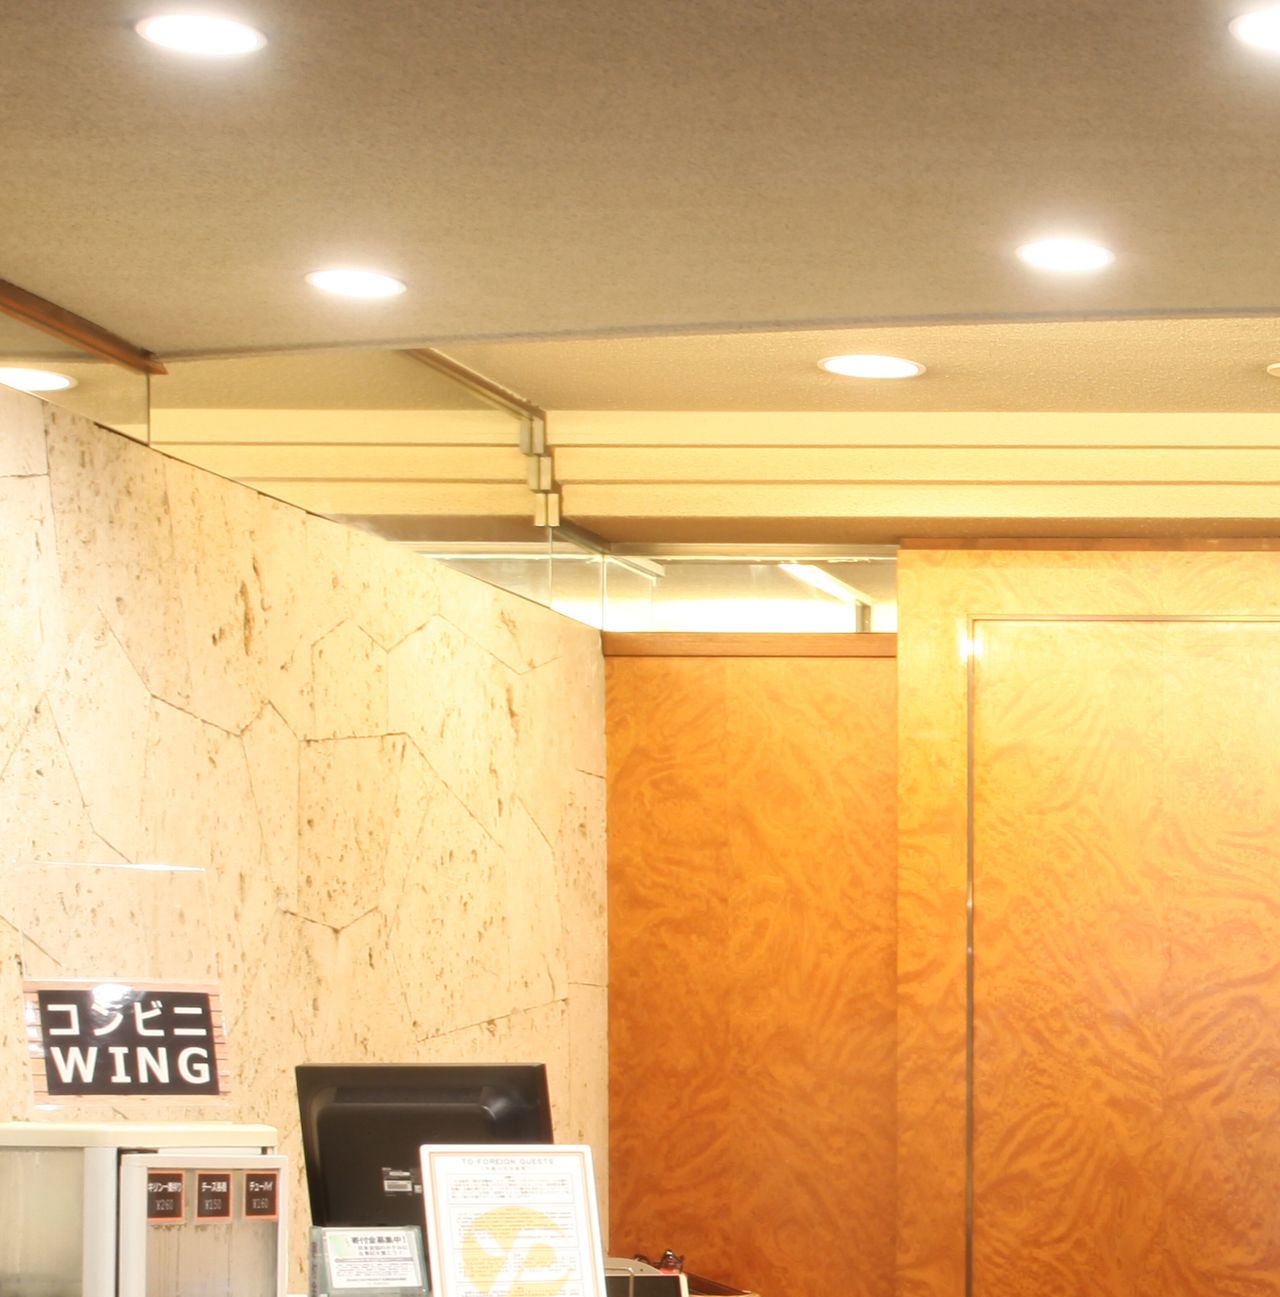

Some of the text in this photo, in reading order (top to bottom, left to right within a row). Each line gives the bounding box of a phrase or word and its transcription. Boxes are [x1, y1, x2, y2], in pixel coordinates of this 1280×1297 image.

[47, 1000, 207, 1036] コンビニ
[50, 1046, 211, 1084] WING
